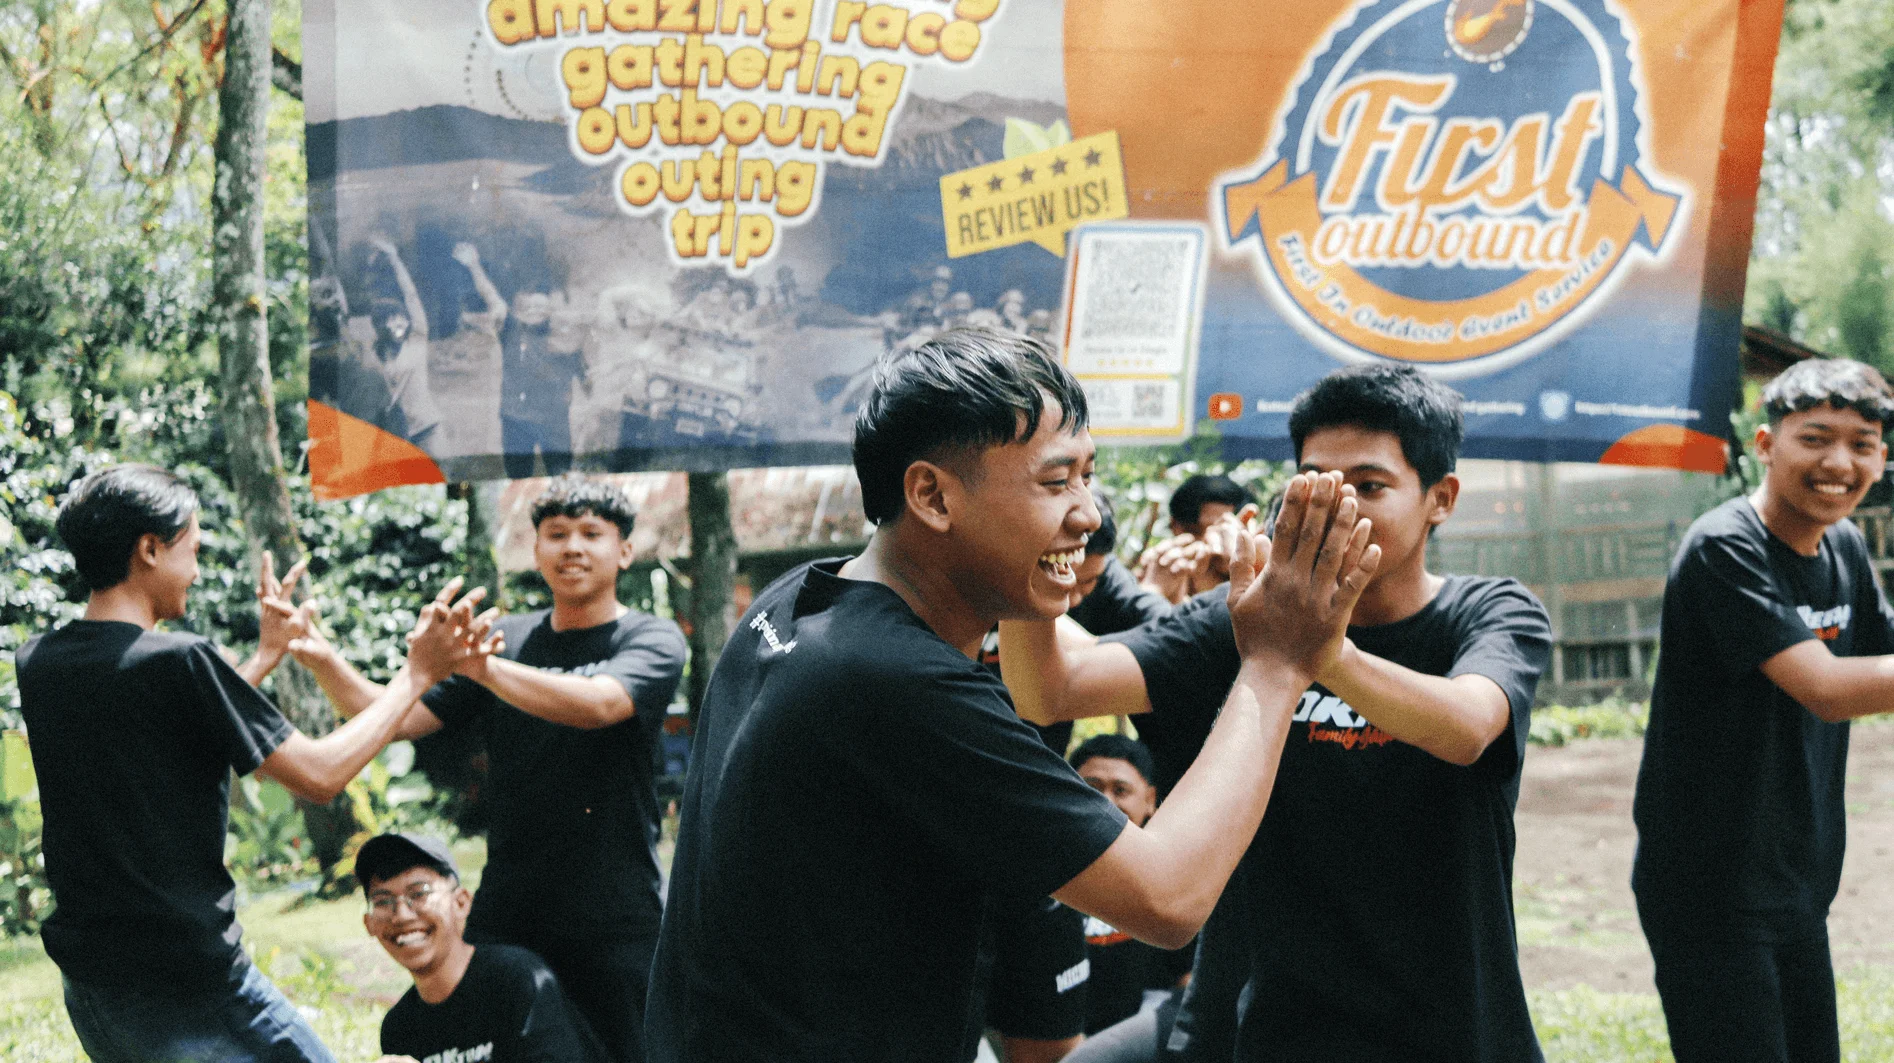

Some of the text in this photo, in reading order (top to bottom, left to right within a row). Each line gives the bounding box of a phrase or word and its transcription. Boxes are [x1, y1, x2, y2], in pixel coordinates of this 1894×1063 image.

[488, 0, 812, 48] amazing
[831, 2, 981, 62] race
[561, 34, 906, 110] gathering
[576, 86, 888, 158] outbound
[1321, 75, 1602, 212] First
[621, 143, 817, 217] outing
[958, 179, 1110, 245] REVIEW US!
[671, 201, 775, 269] trip
[1316, 202, 1589, 267] outbound
